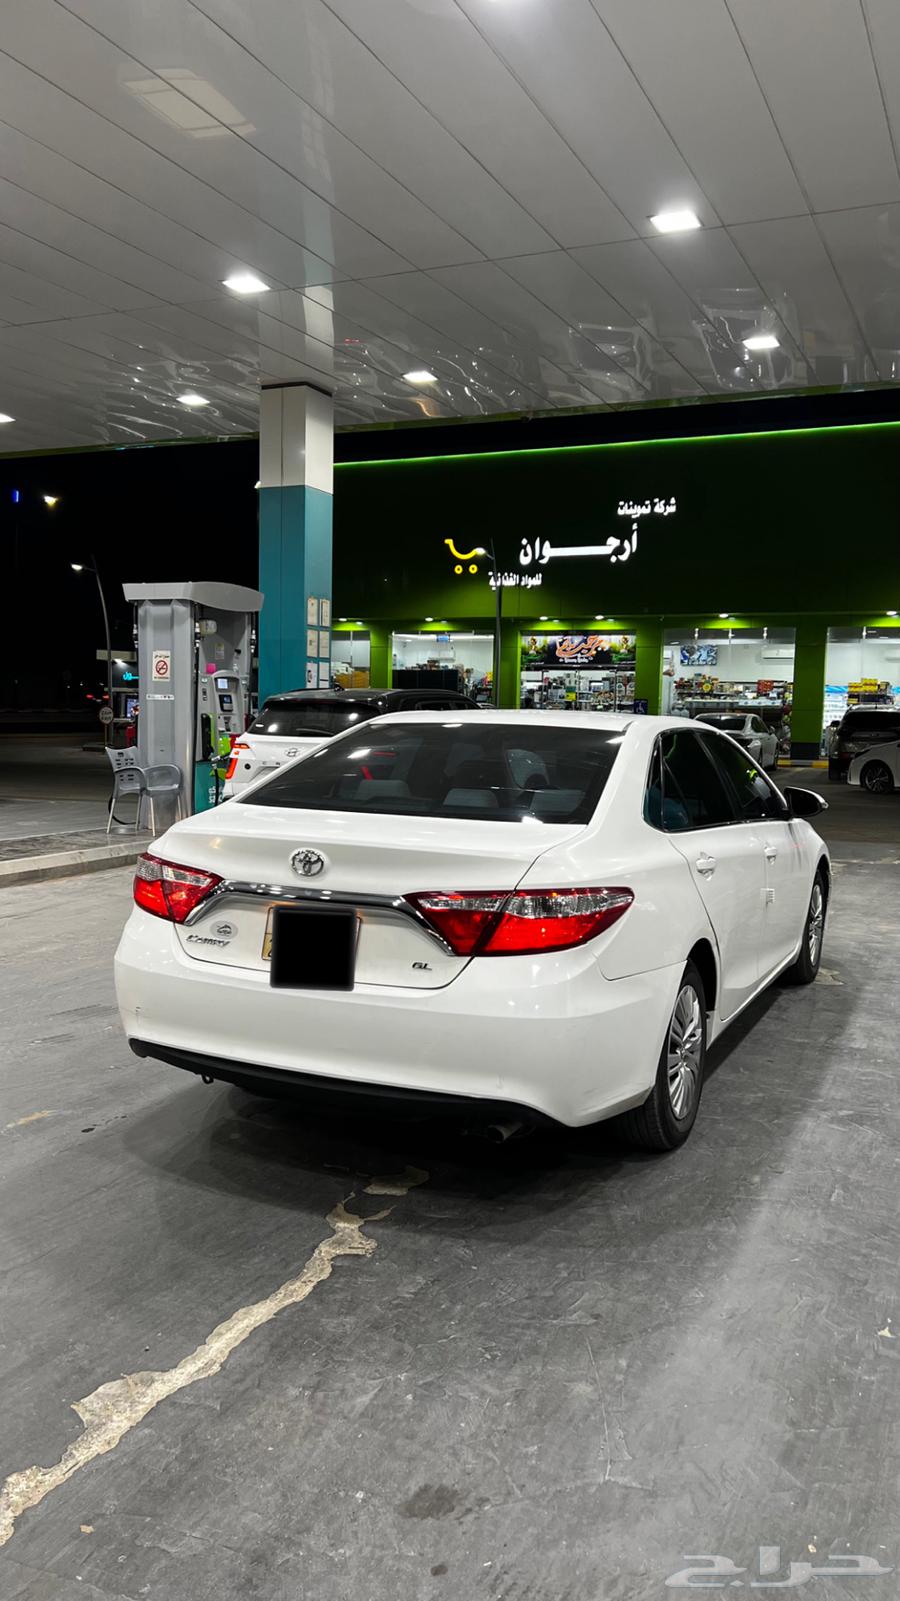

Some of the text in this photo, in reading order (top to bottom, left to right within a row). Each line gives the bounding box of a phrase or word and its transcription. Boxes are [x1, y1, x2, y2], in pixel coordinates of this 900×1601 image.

[617, 496, 677, 519] شركة تموينات
[520, 572, 543, 589] للمواد
[411, 961, 433, 971] GL
